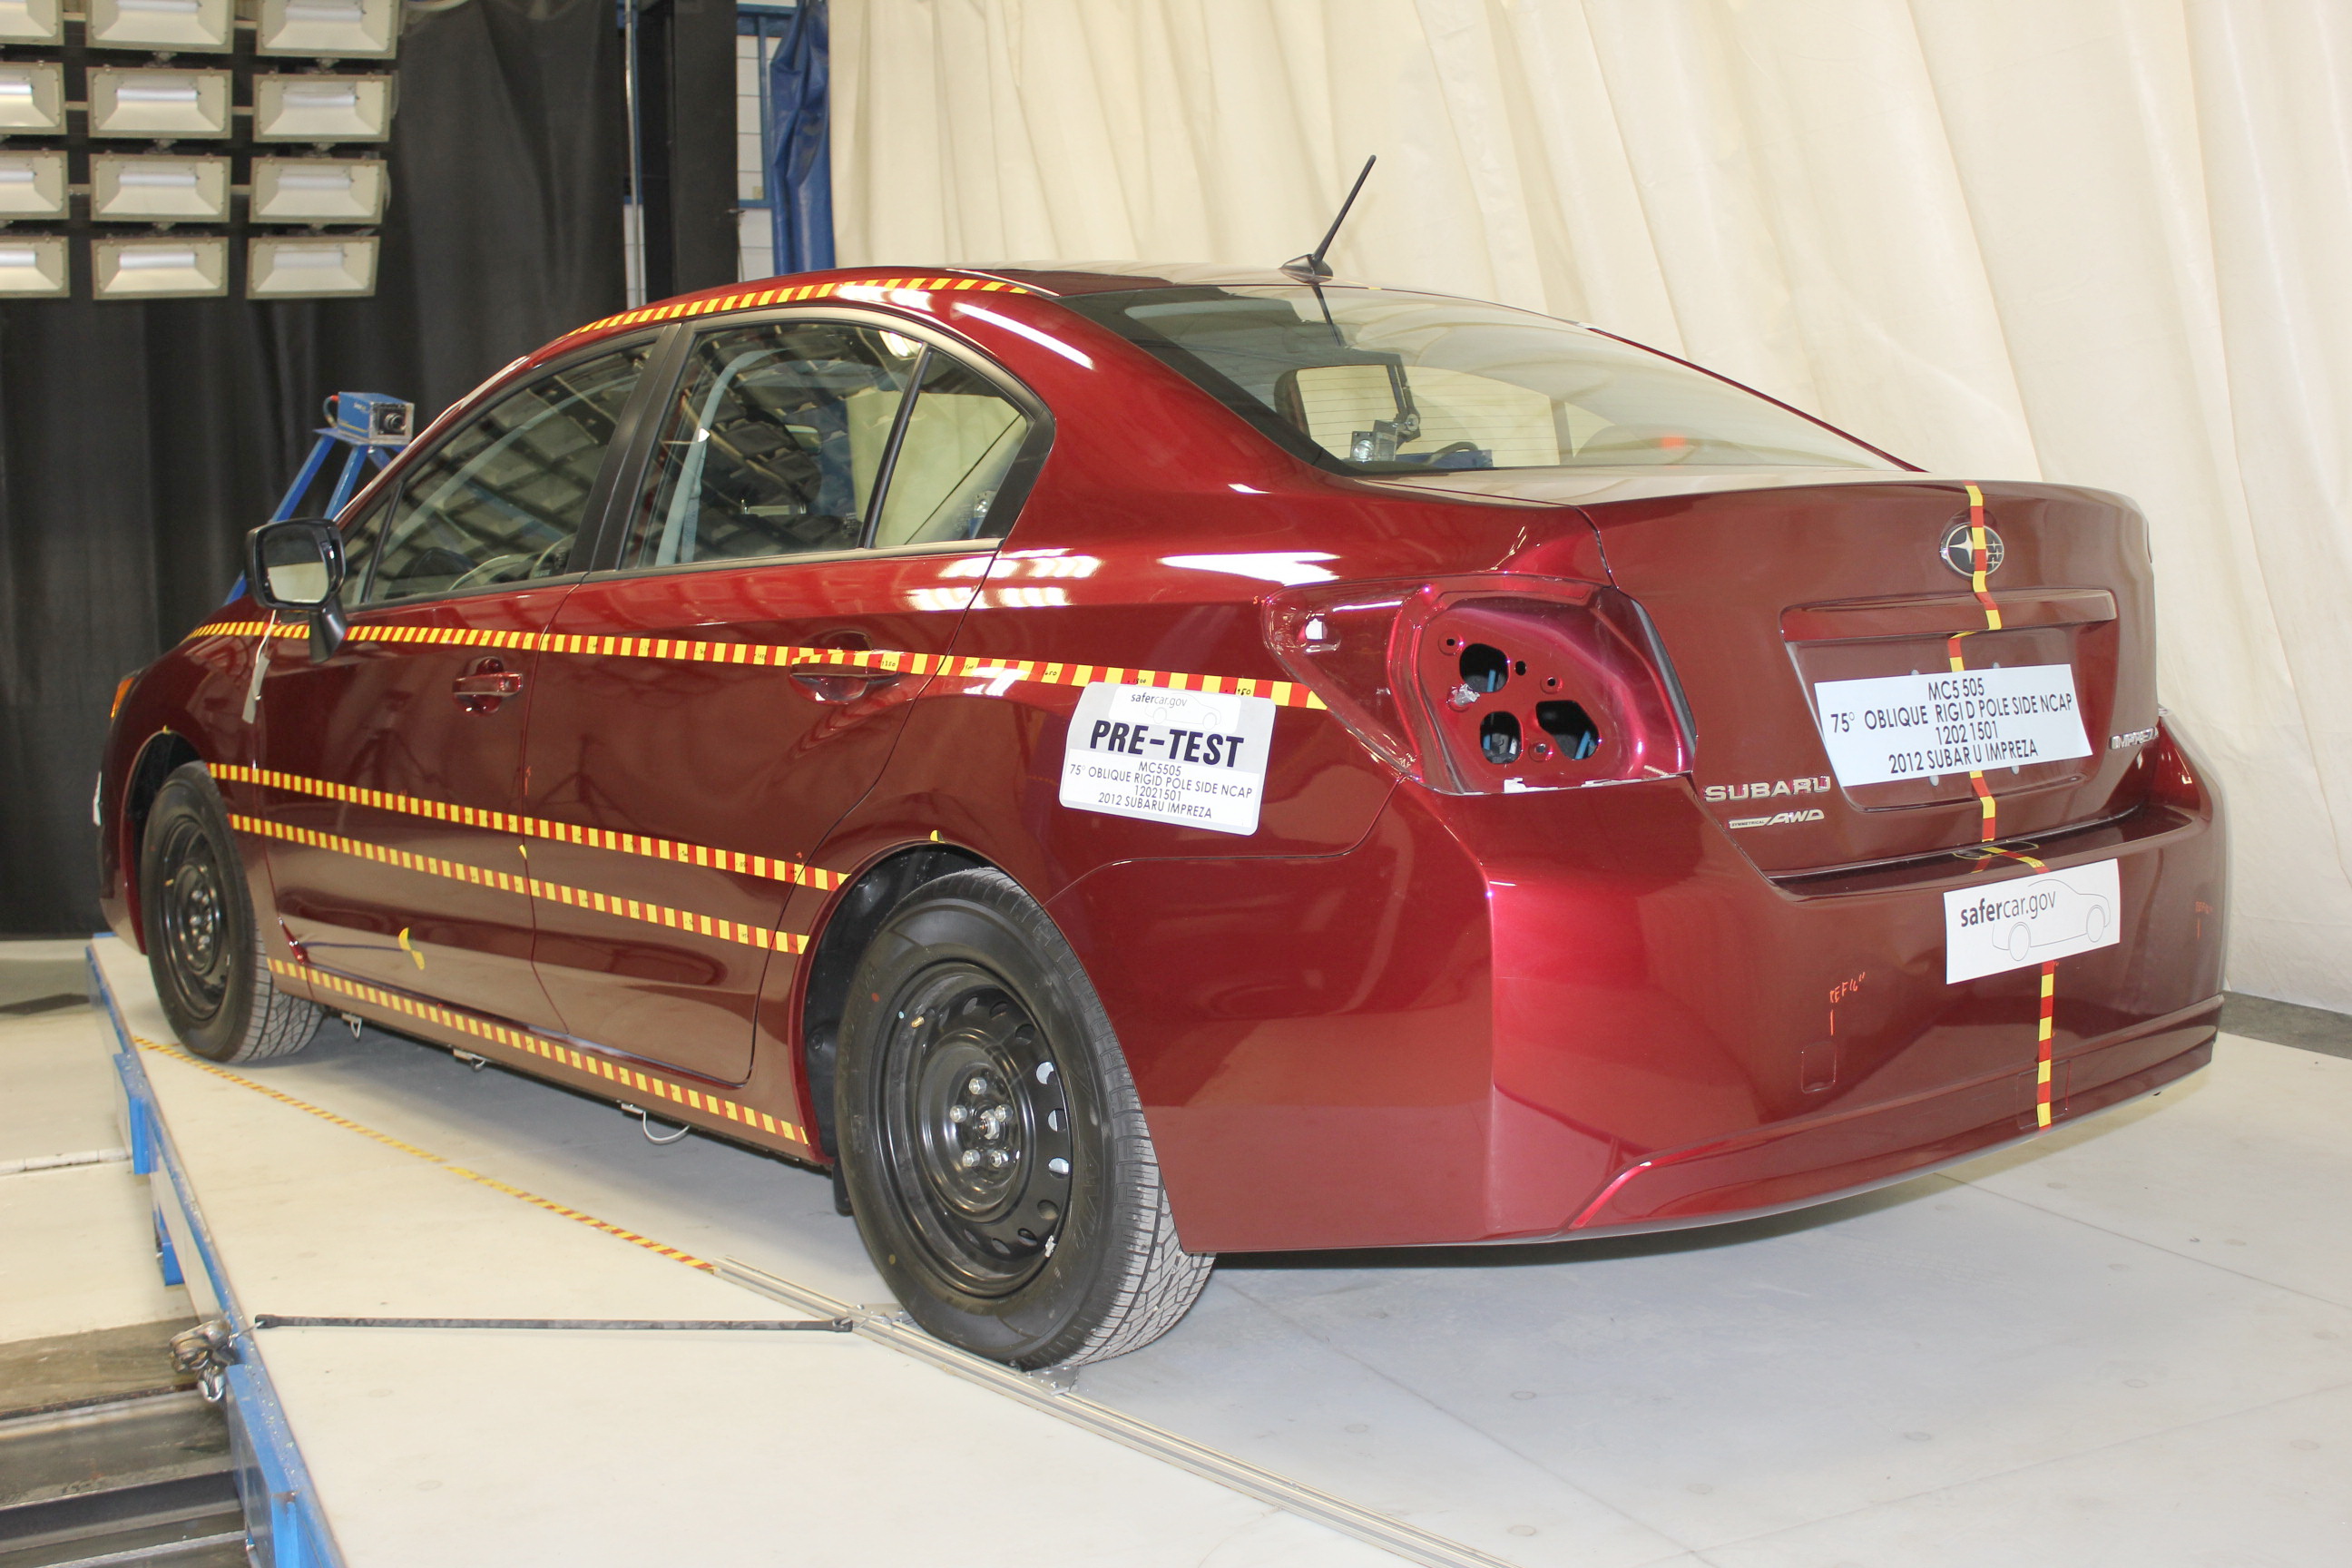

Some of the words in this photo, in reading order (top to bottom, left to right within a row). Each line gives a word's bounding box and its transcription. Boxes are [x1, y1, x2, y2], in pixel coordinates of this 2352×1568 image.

[1131, 691, 1187, 709] safercar.gov
[1864, 705, 1928, 730] OBLIQUE
[1979, 697, 2010, 719] POLE
[2013, 695, 2039, 715] SIDE
[2041, 692, 2073, 712] NCAP
[1090, 720, 1244, 768] PRE-TEST
[1888, 752, 1924, 774] 2012
[1985, 739, 2039, 762] IMPREZA
[1138, 760, 1181, 777] MC5505
[1088, 767, 1131, 783] OBLIQUE
[1133, 772, 1162, 788] RIGID
[1165, 777, 1192, 791] POLE
[1194, 780, 1218, 795] SIDE
[1220, 784, 1253, 799] NCAP
[1134, 784, 1181, 802] 12021501
[1705, 776, 1831, 802] SUBARU
[1098, 791, 1122, 806] 2012
[1124, 796, 1164, 812] SUBARU
[1167, 800, 1212, 818] IMPREZA
[1767, 809, 1825, 826] AWD
[1960, 891, 2056, 927] safercar.gov
